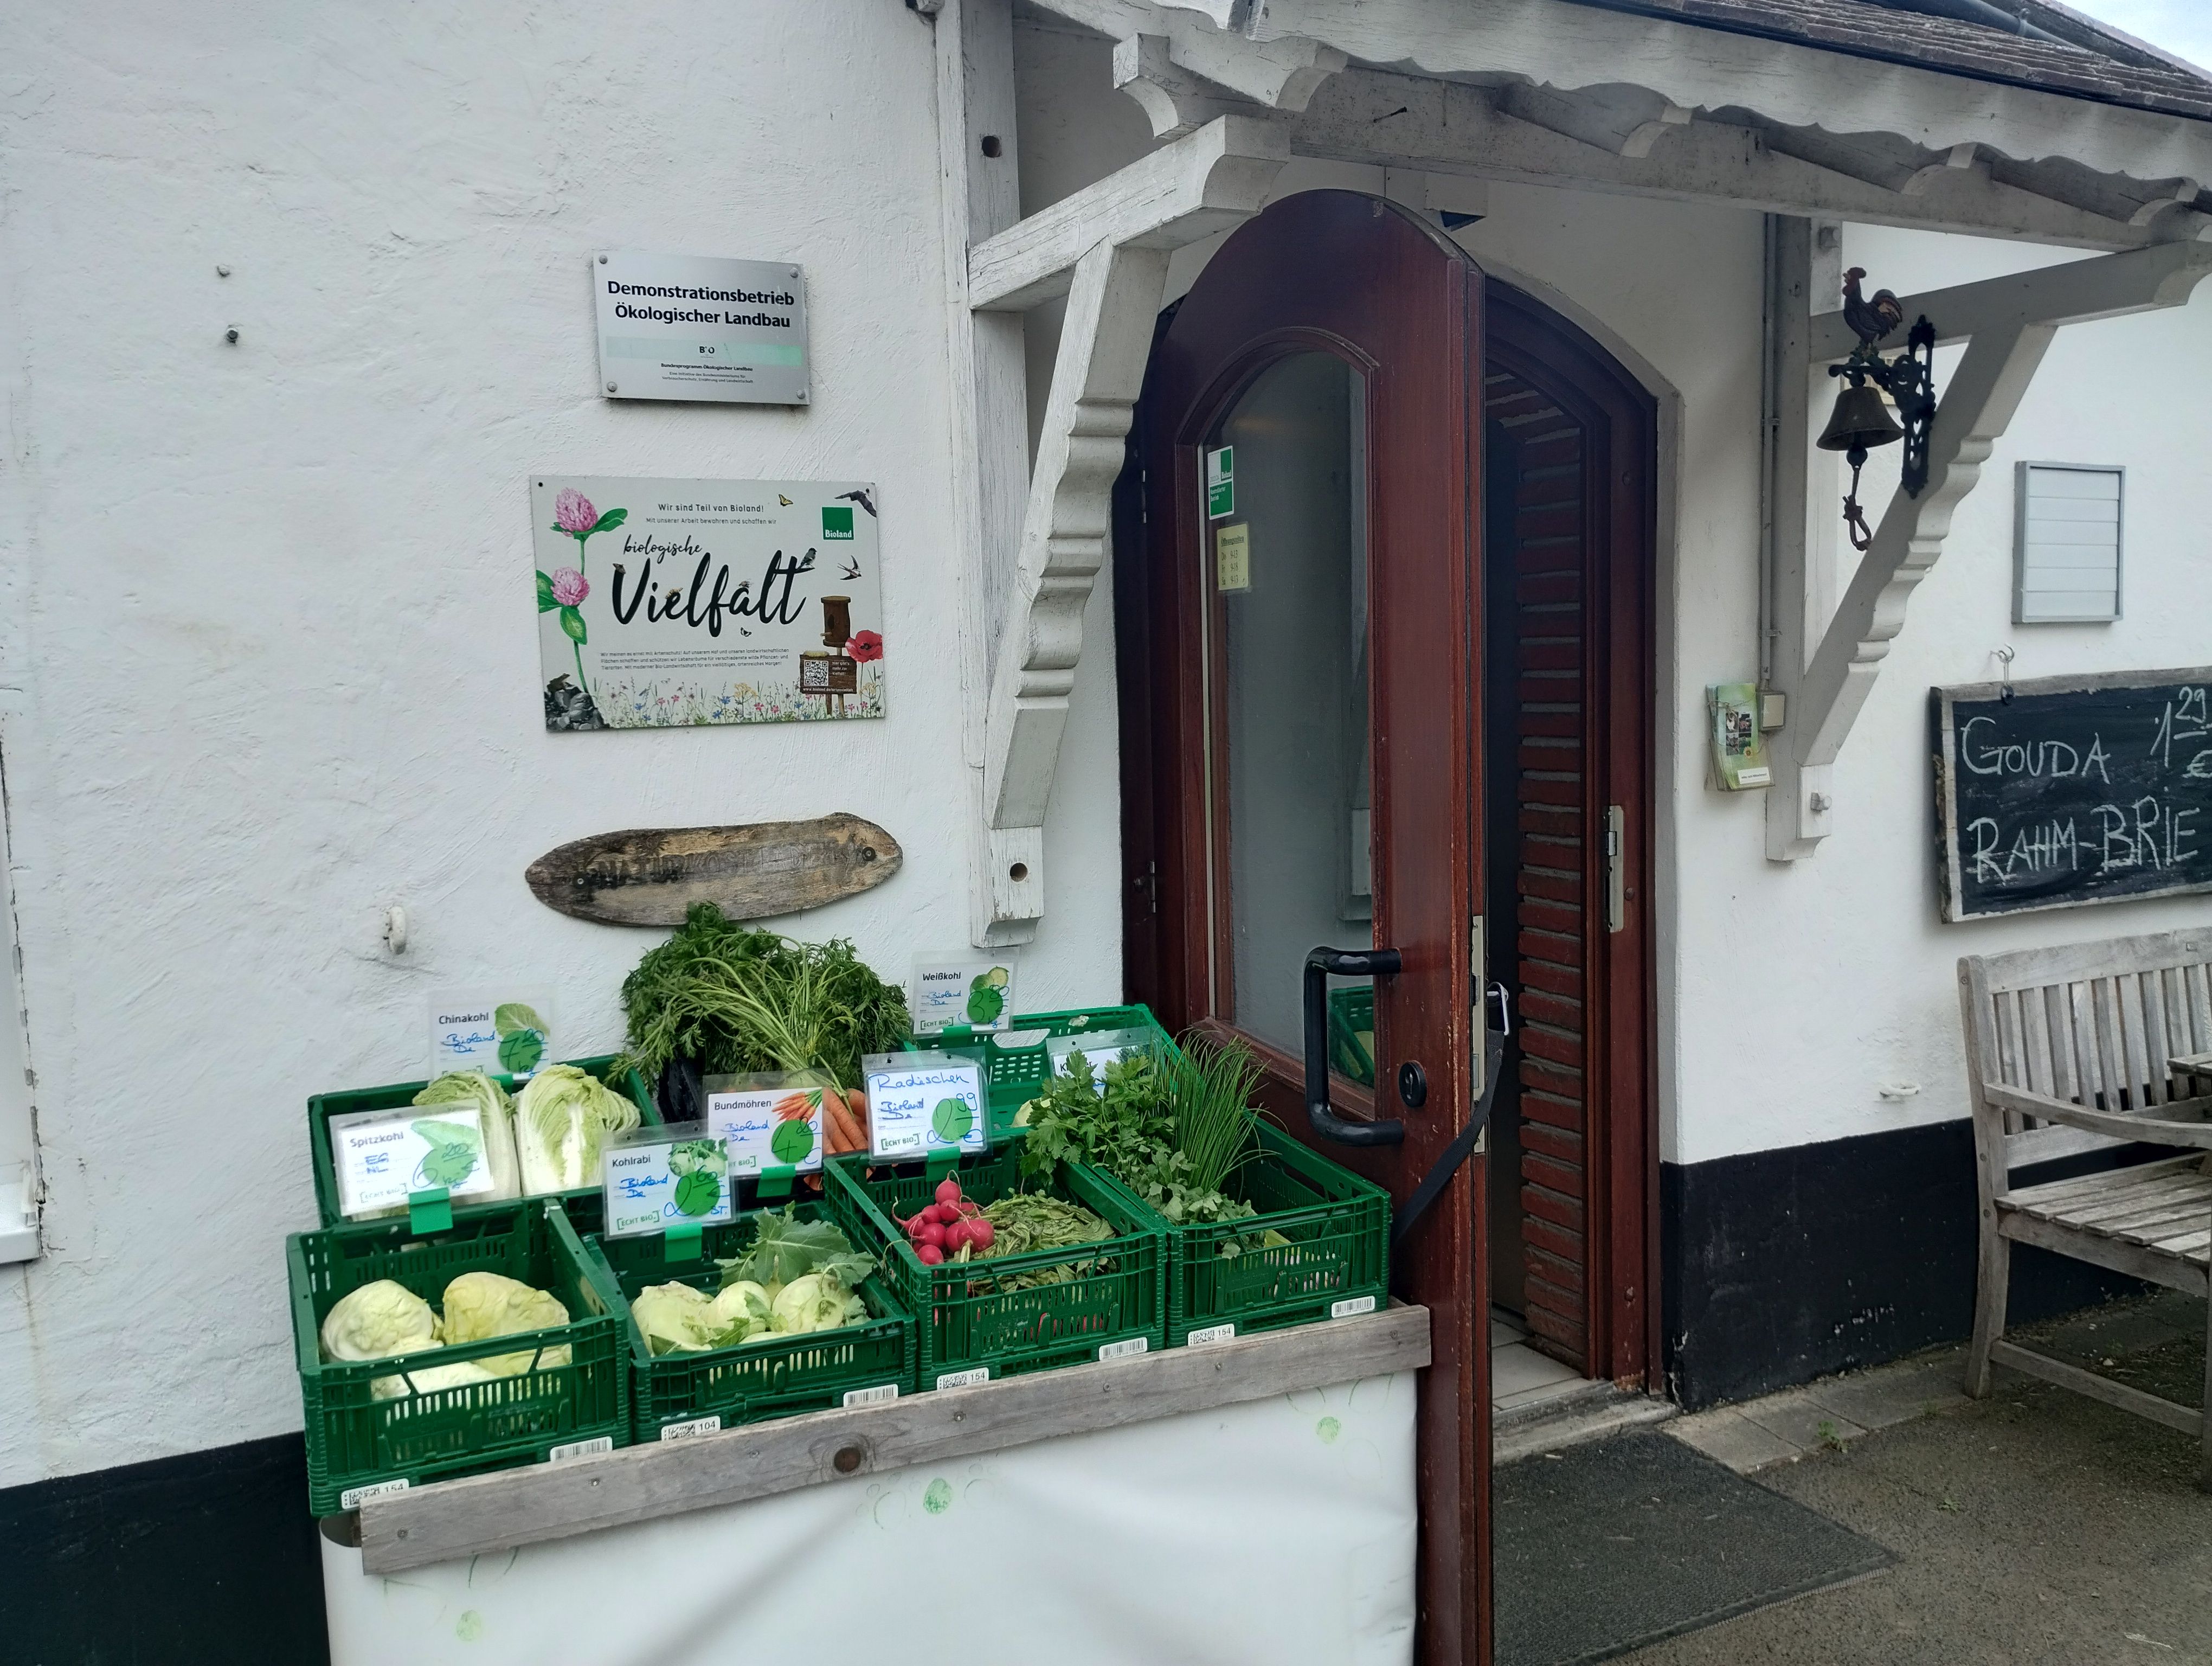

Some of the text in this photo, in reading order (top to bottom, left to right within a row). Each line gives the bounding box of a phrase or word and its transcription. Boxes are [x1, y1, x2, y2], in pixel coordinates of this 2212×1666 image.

[607, 280, 795, 306] Demonstrationsbetrieb
[615, 302, 791, 328] Ökologischer Landbau
[699, 346, 715, 354] BO
[730, 504, 764, 512] Bioland!
[824, 529, 853, 539] Bioland
[623, 534, 703, 565] biologische
[612, 549, 816, 638] Vielfalt
[1960, 716, 2112, 785] GOUDA
[1965, 794, 2201, 886] RAHM-BRIE
[922, 971, 962, 982] Weißkohl
[928, 990, 962, 999] Bioland
[438, 1012, 490, 1024] Chinakohl
[442, 1030, 496, 1047] Bioland
[714, 1099, 772, 1111] Bundmöhren
[721, 1119, 770, 1132] Bioland
[349, 1131, 404, 1148] Spitzkohl
[612, 1154, 651, 1168] Kohlrabi
[970, 1372, 985, 1381] 154
[699, 1420, 716, 1431] 104
